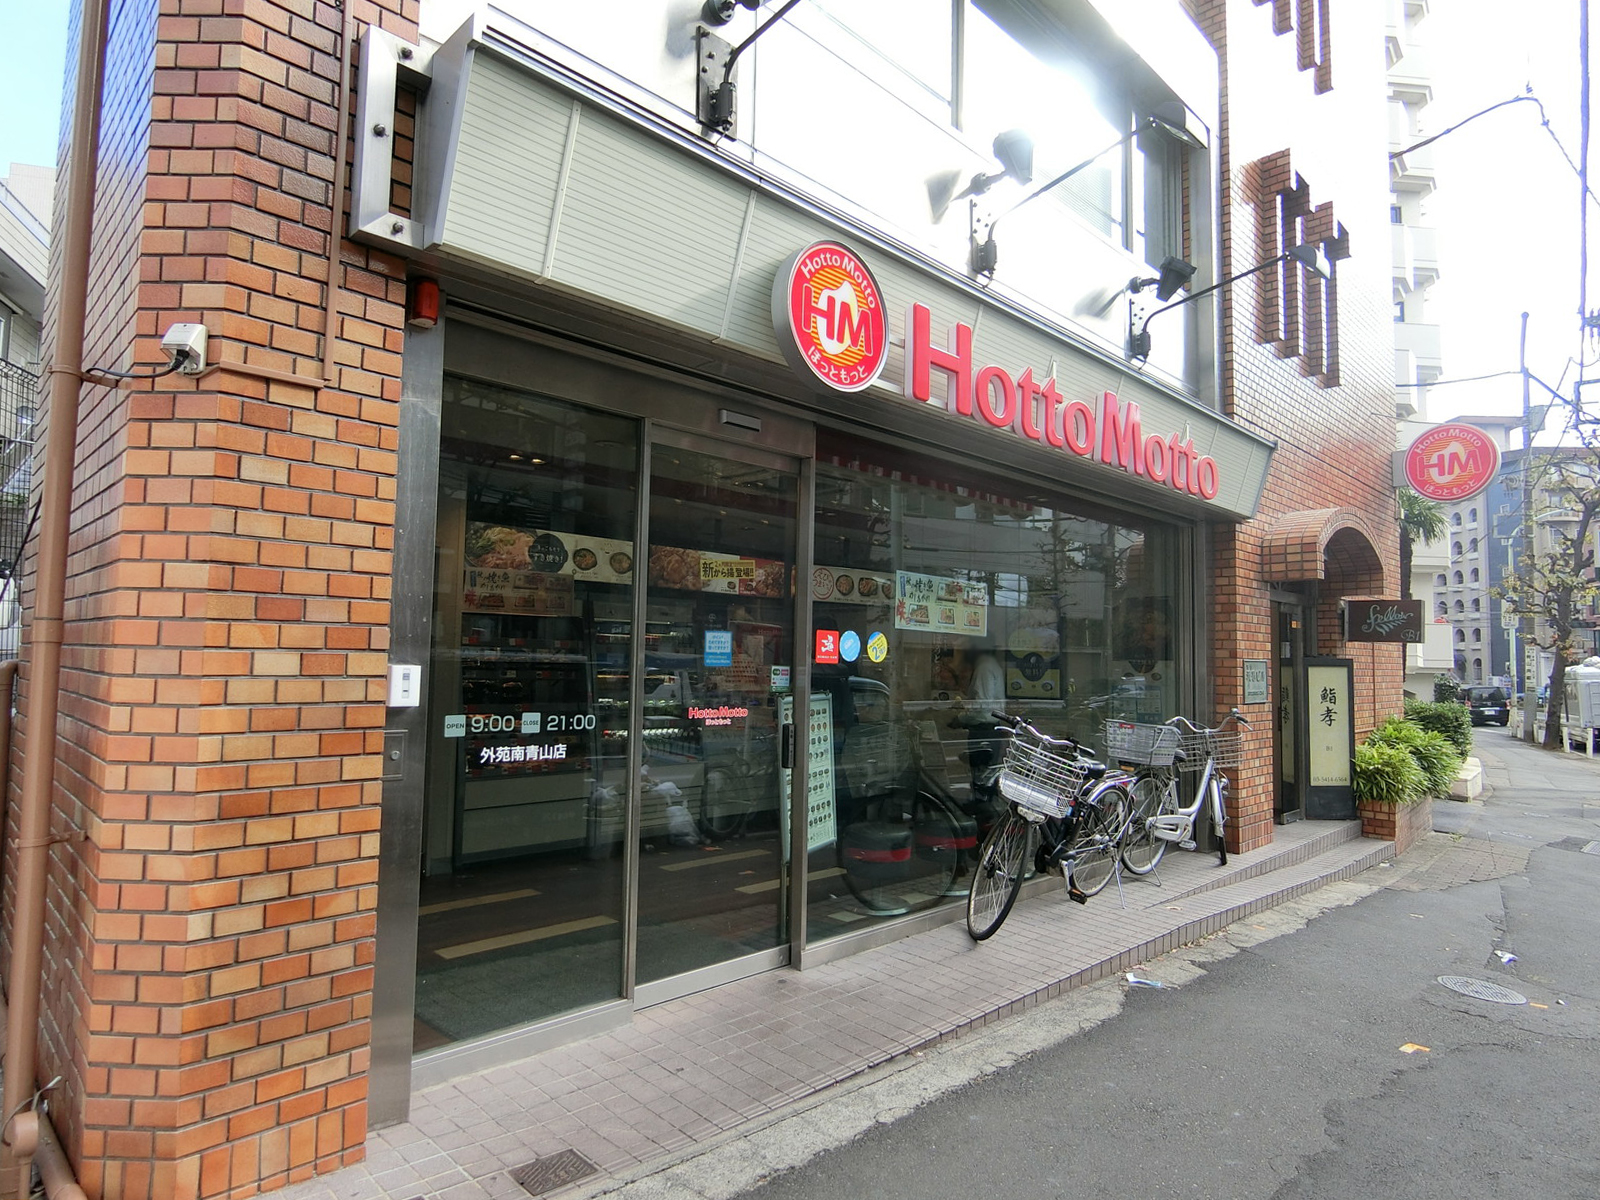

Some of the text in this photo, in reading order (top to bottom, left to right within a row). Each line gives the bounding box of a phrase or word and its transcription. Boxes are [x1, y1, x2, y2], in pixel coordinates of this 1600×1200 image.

[801, 283, 873, 356] HM
[807, 345, 868, 384] ほっともっと
[1417, 449, 1482, 479] HM
[1424, 480, 1478, 497] ほっともっと
[1320, 687, 1338, 727] 鮨孝
[471, 716, 516, 733] 9:00
[547, 714, 597, 731] 21:00
[480, 744, 568, 764] 外苑南青山店
